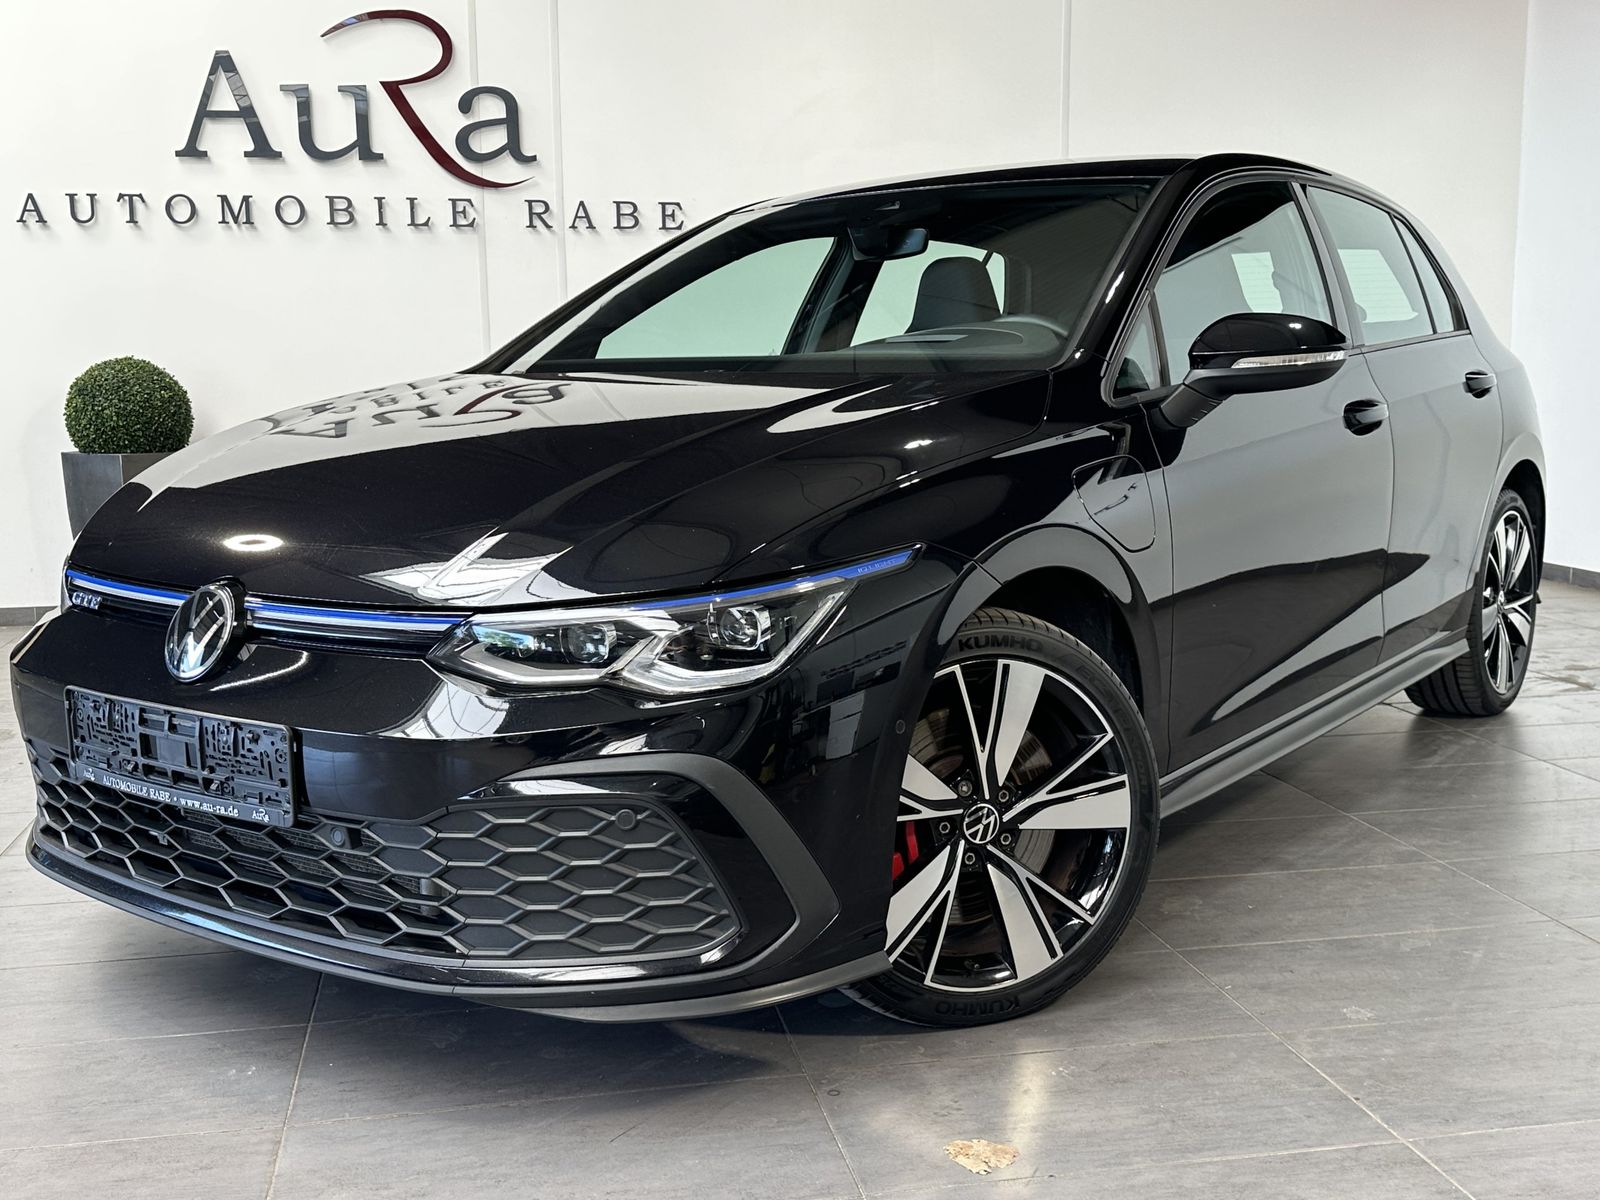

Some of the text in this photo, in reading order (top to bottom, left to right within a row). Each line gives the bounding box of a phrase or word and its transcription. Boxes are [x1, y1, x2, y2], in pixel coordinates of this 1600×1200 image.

[175, 9, 537, 188] AuRa
[16, 193, 686, 231] AUTOMOBILE RABE
[957, 634, 1043, 653] KUMHO
[102, 775, 149, 797] AUTOMOBILE
[150, 785, 171, 802] RABE
[180, 796, 239, 818] www.au-ra.de
